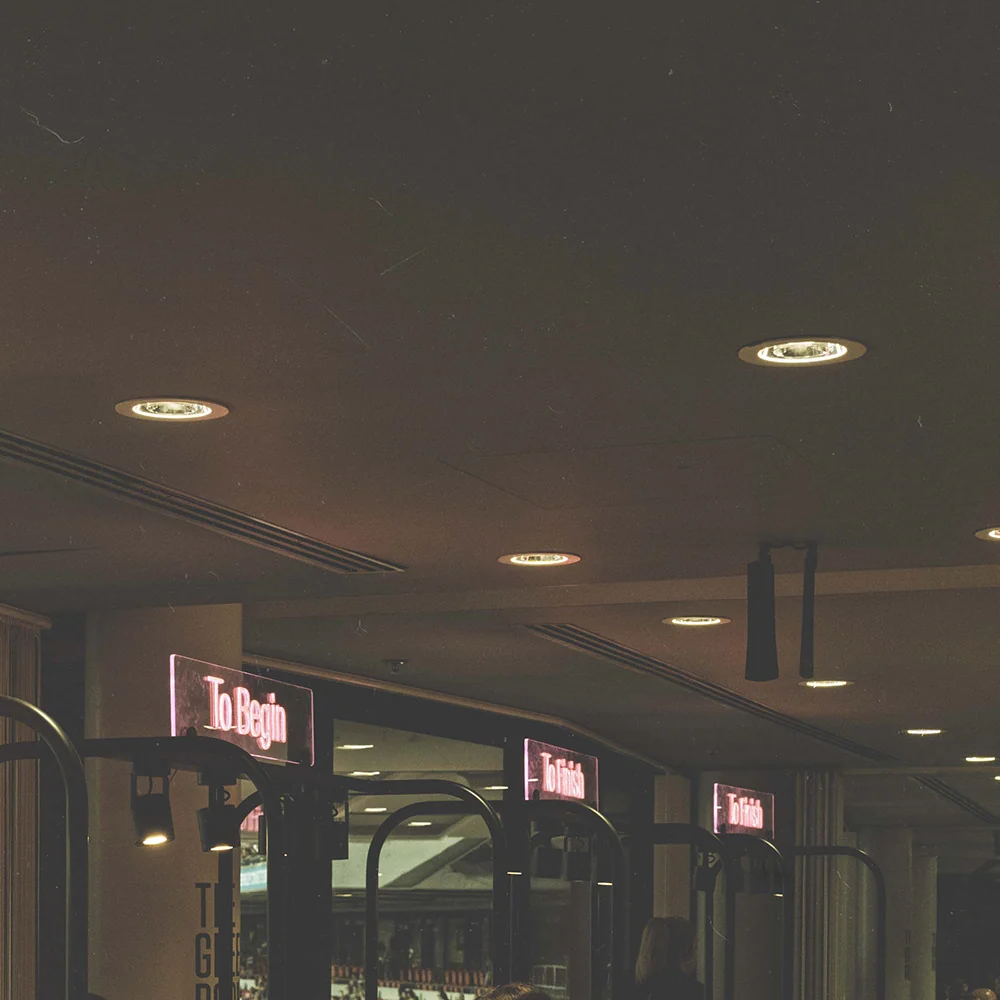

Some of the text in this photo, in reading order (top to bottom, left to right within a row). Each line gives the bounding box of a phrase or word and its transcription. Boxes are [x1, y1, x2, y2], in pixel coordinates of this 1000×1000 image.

[203, 675, 287, 751] To Begin
[539, 752, 585, 799] To Finish
[726, 793, 763, 829] To Finish
